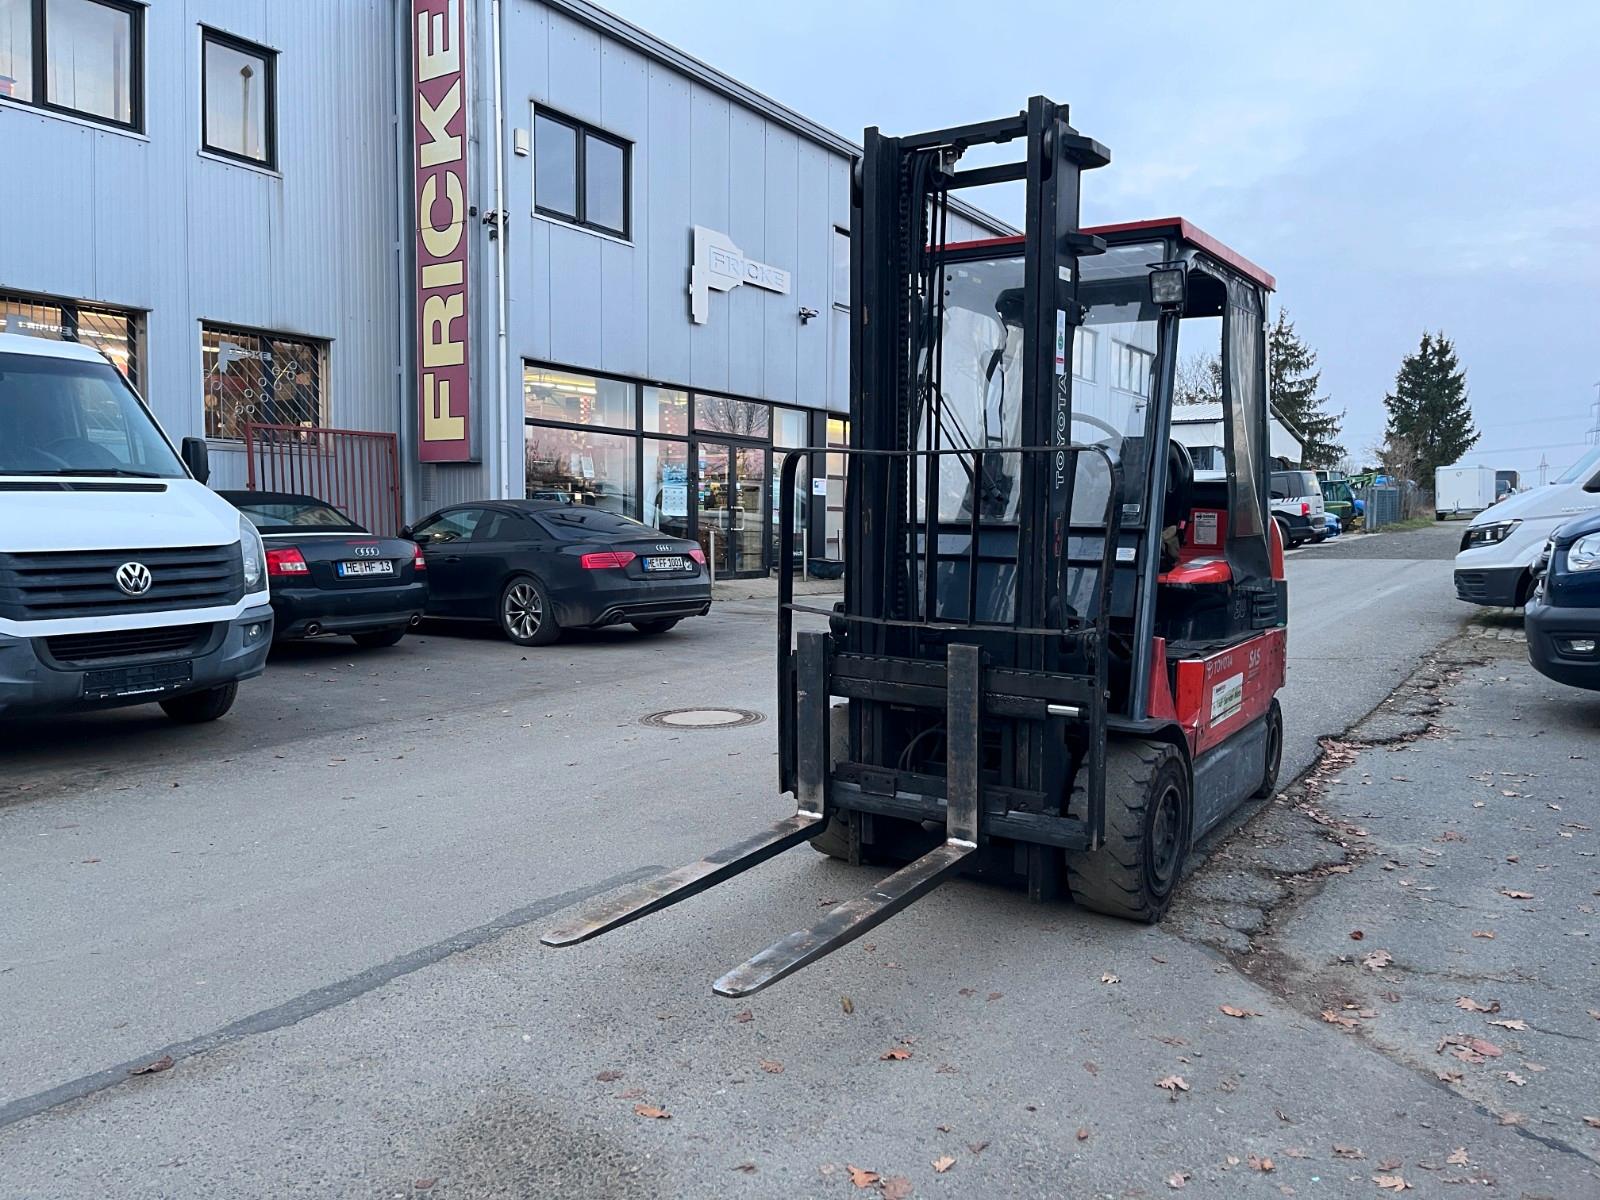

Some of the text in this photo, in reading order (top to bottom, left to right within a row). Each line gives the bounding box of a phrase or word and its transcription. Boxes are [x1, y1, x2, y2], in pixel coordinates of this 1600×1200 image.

[417, 0, 465, 441] FRICKE
[712, 250, 785, 288] FRICKE
[1055, 371, 1067, 490] TOYOTA
[345, 560, 391, 573] HE HF 13
[1214, 654, 1233, 676] TOYOTA
[1248, 647, 1261, 669] SAS
